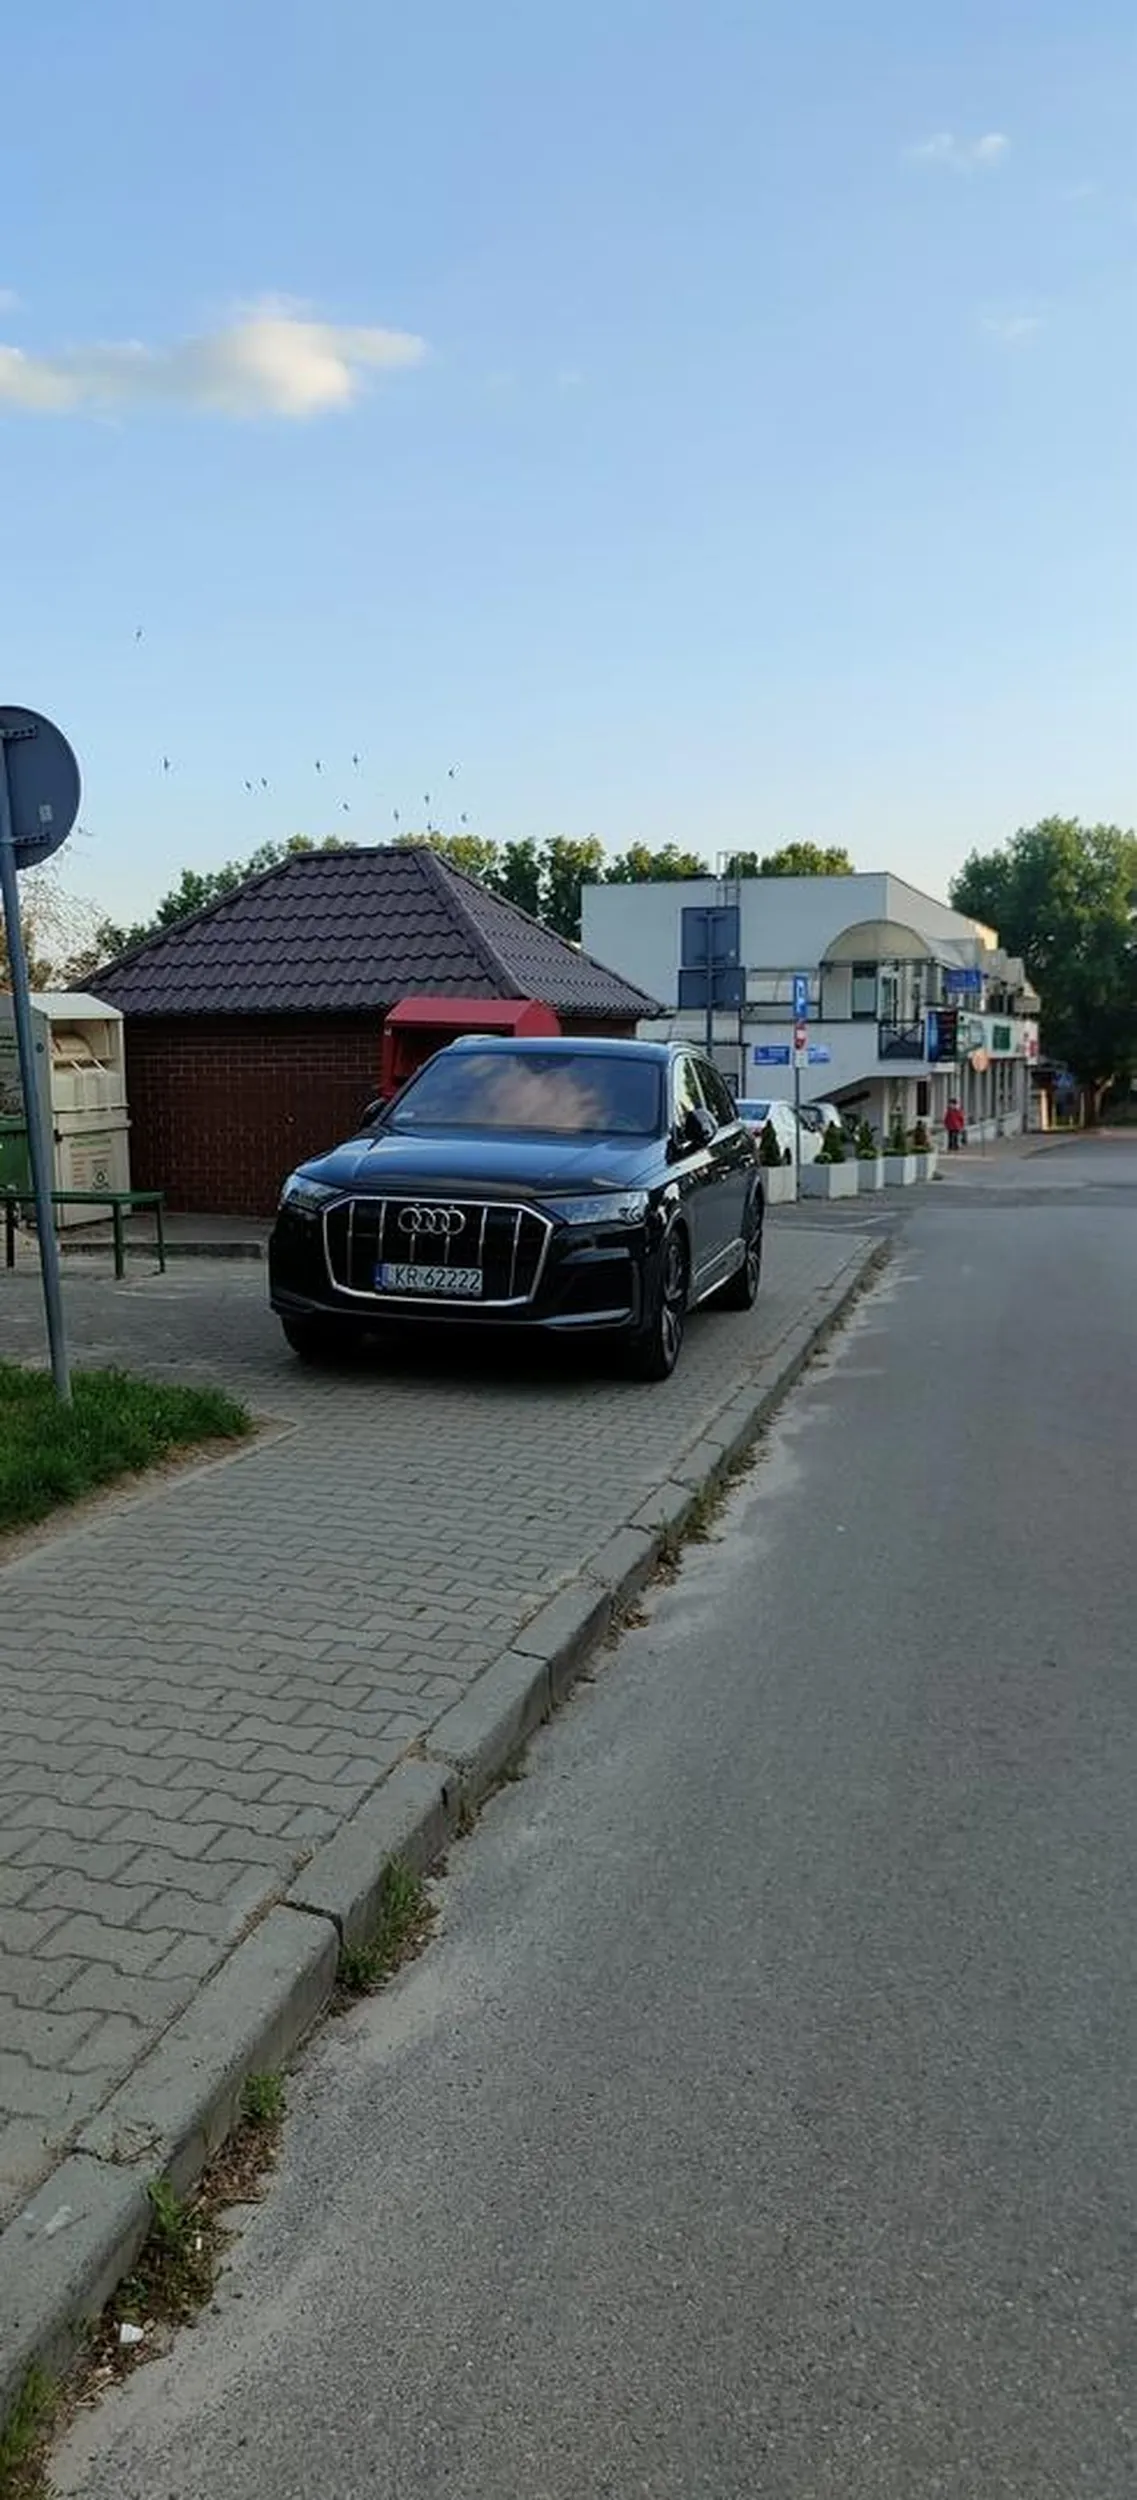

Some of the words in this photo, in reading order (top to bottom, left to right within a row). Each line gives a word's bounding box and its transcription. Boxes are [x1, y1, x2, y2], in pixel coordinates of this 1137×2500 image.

[795, 978, 805, 1012] P
[383, 1266, 418, 1287] LKR
[424, 1268, 481, 1291] 62222
